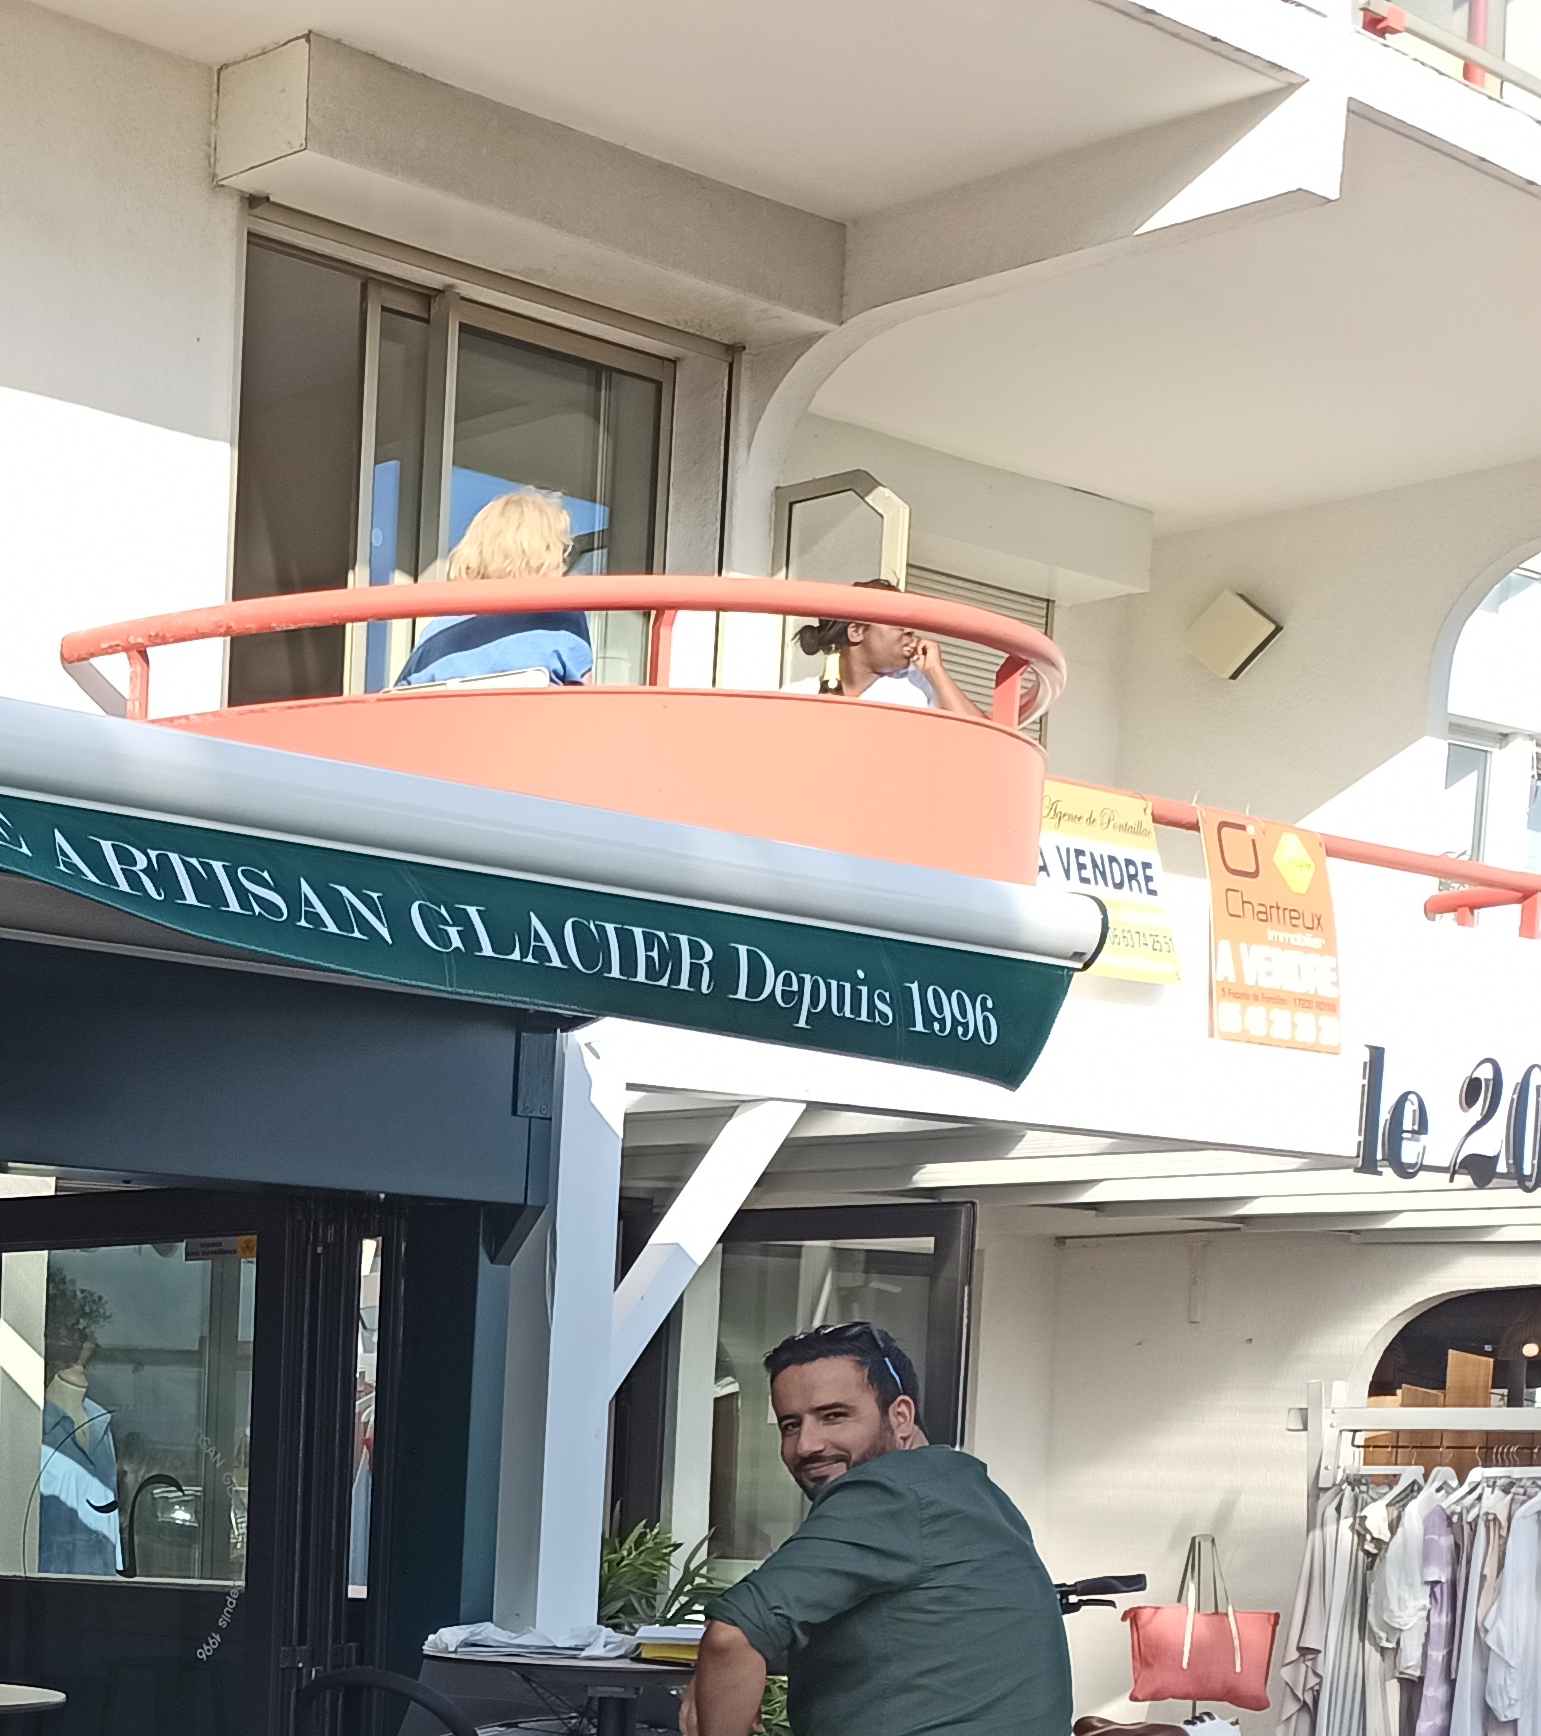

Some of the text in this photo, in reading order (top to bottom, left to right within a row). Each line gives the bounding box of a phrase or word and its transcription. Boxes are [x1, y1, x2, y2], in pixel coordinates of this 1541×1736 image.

[1042, 795, 1084, 829] Agence
[1085, 810, 1098, 827] de
[1055, 845, 1158, 896] VENDRE
[1225, 887, 1324, 931] Chartreux
[54, 828, 392, 946] ARTISAN
[411, 900, 714, 996] GLACIER
[728, 943, 894, 1030] Depuis
[903, 981, 999, 1046] 1996
[1216, 939, 1339, 999] A VENDRE
[1353, 1043, 1428, 1180] le
